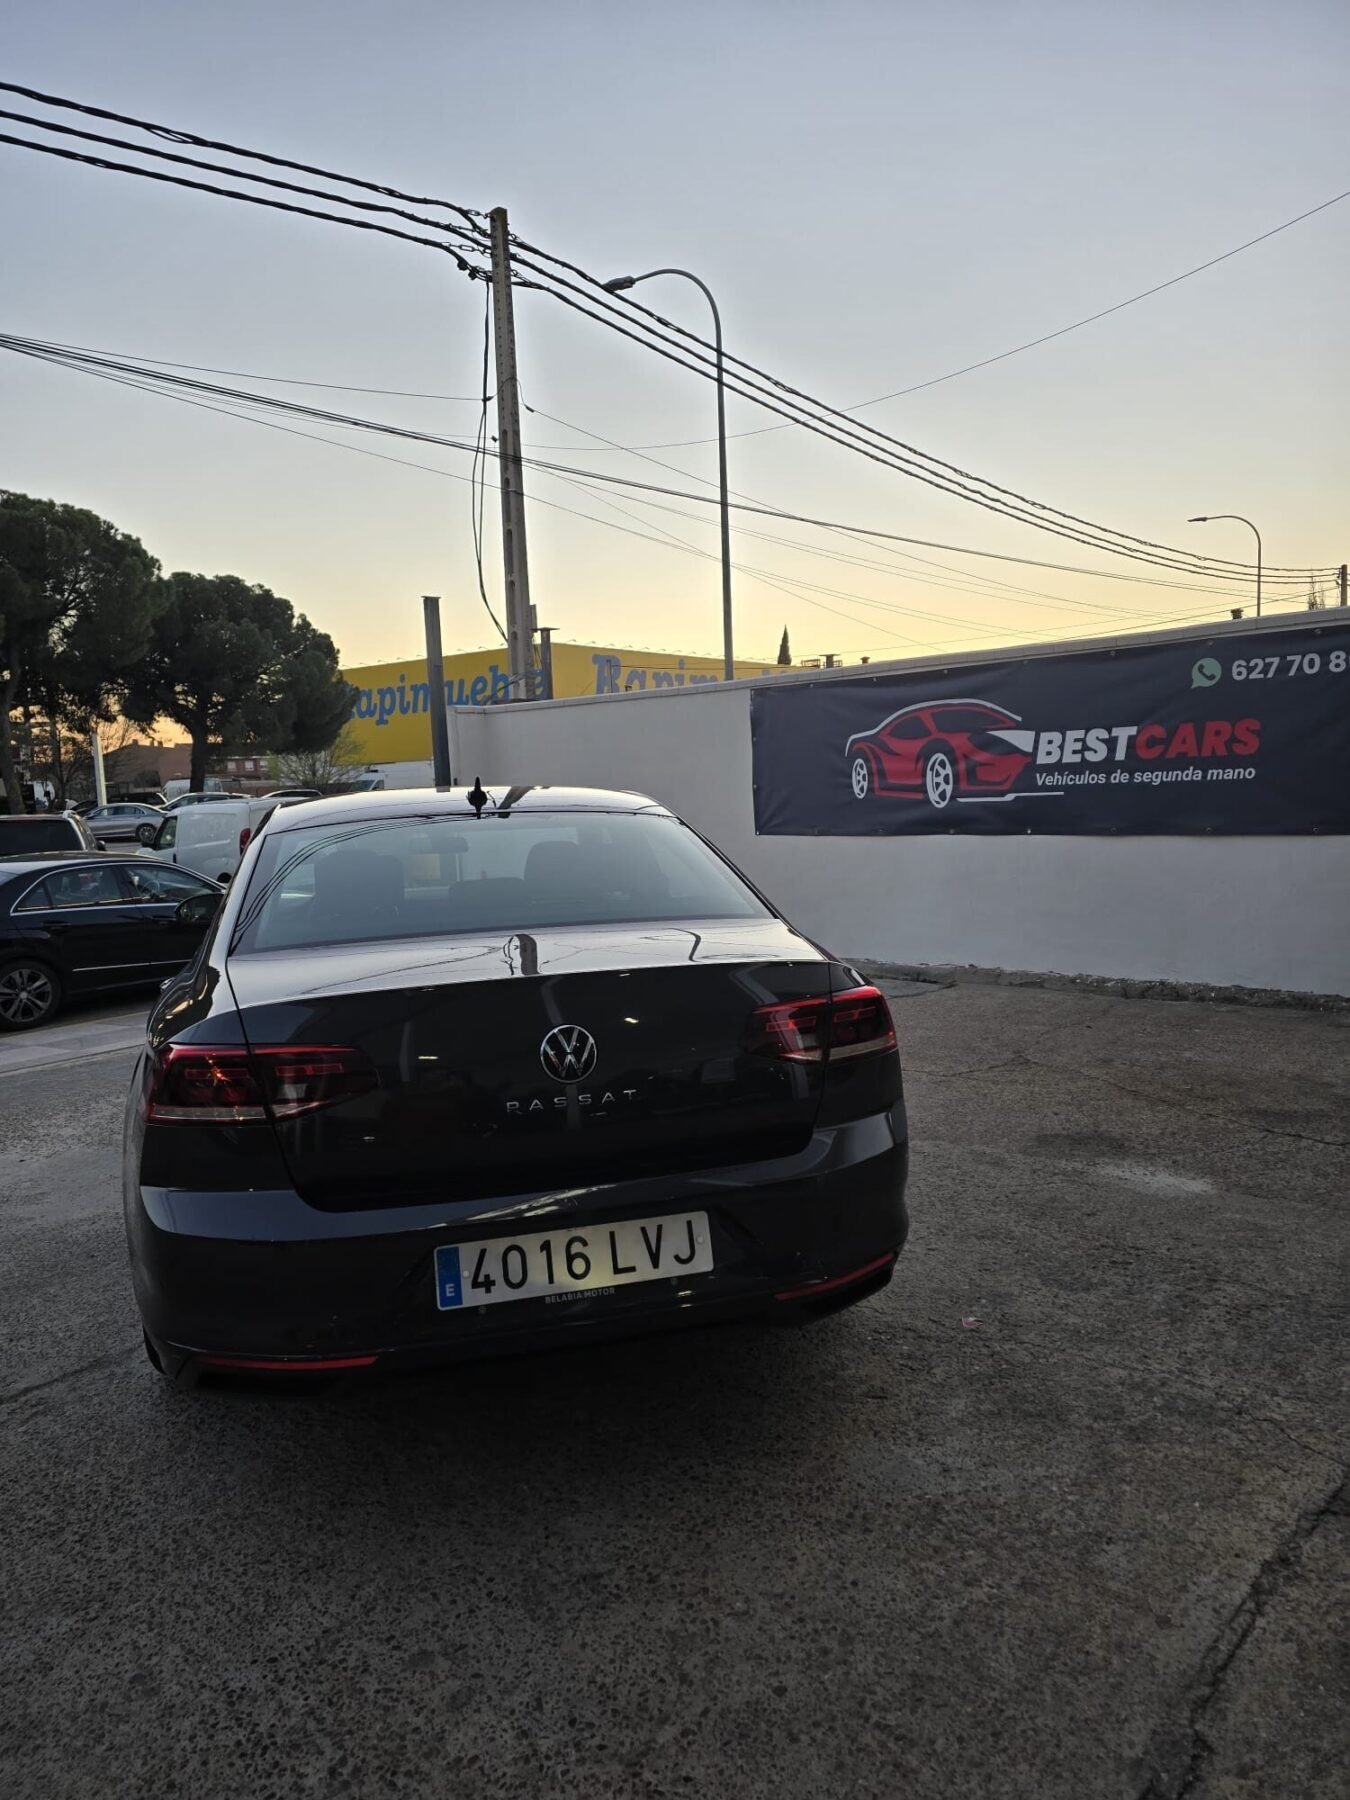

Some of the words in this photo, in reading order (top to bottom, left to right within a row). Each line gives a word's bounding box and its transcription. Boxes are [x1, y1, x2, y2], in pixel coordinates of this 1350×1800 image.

[1231, 656, 1281, 681] 627
[1286, 652, 1321, 677] 70
[1328, 650, 1350, 673] 8
[1036, 718, 1262, 765] BESTCARS
[1036, 770, 1106, 786] Vehículos
[1110, 768, 1130, 784] de
[1133, 766, 1203, 785] segunda
[1206, 767, 1256, 781] mano
[506, 1089, 638, 1113] PASSAT
[446, 1283, 455, 1297] E
[471, 1235, 592, 1294] 4016
[609, 1219, 697, 1276] LVJ
[583, 1287, 616, 1298] MOTOR
